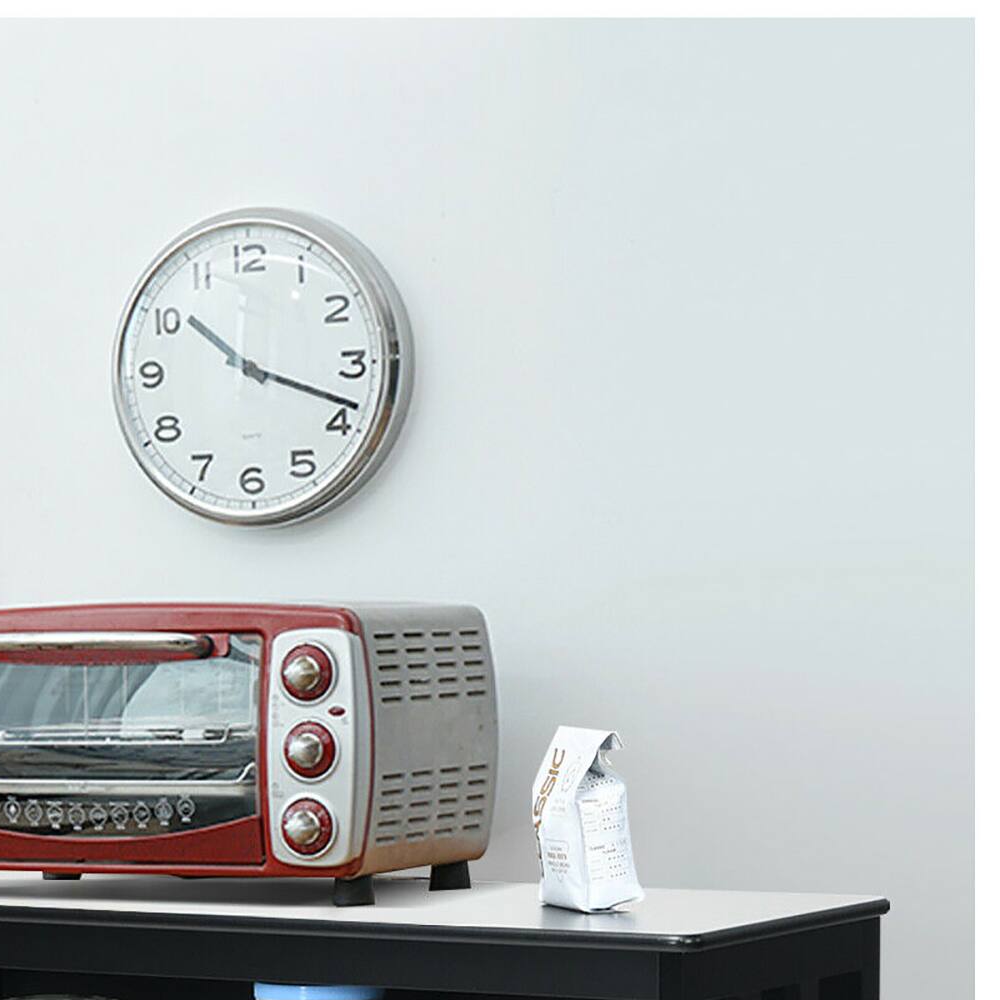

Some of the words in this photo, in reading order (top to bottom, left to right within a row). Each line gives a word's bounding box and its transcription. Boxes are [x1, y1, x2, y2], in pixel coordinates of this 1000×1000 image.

[233, 244, 267, 274] 12
[297, 255, 305, 283] 1
[193, 261, 211, 290] 11
[154, 307, 181, 336] 10
[324, 294, 350, 324] 2
[138, 361, 165, 389] 9
[338, 350, 367, 379] 3
[153, 415, 182, 443] 8
[325, 408, 352, 437] 4
[190, 453, 214, 482] 7
[289, 450, 317, 478] 5
[239, 467, 266, 496] 6
